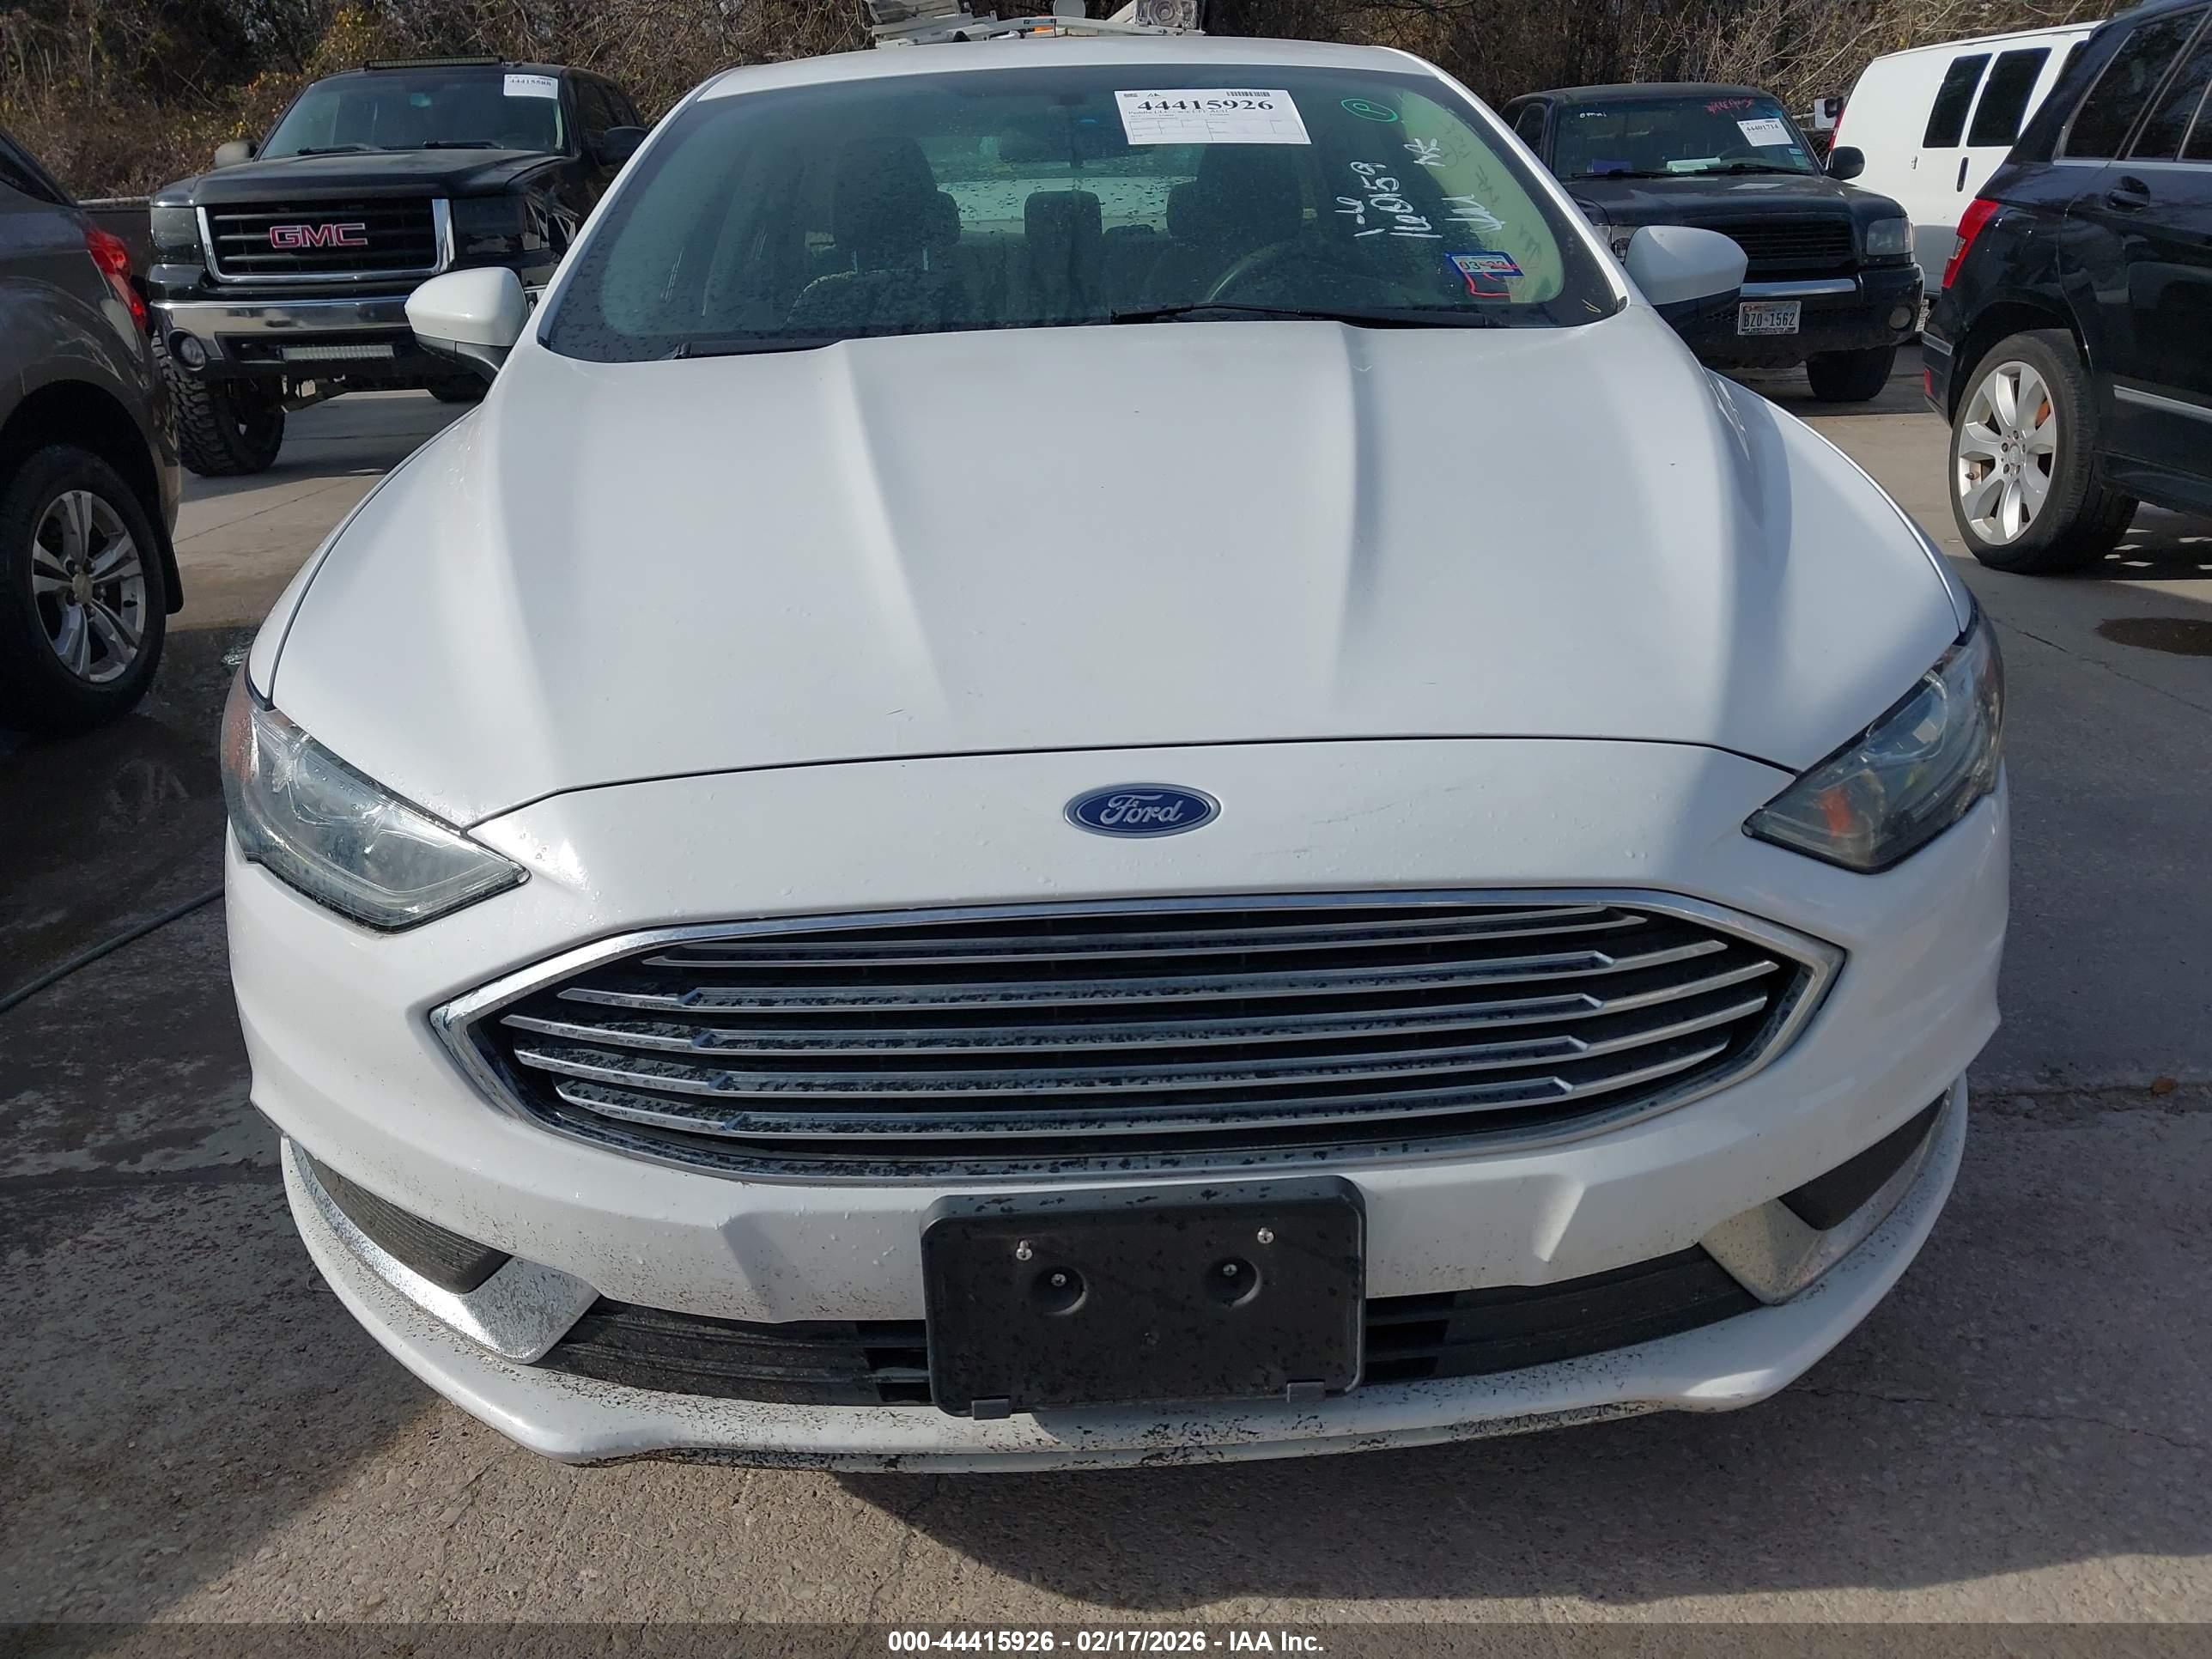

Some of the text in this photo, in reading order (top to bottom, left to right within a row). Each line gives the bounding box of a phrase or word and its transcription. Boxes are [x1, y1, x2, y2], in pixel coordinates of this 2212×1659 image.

[1137, 100, 1274, 111] 44415926
[270, 223, 368, 248] GMC
[1770, 312, 1796, 326] 1562
[1099, 794, 1183, 824] Ford
